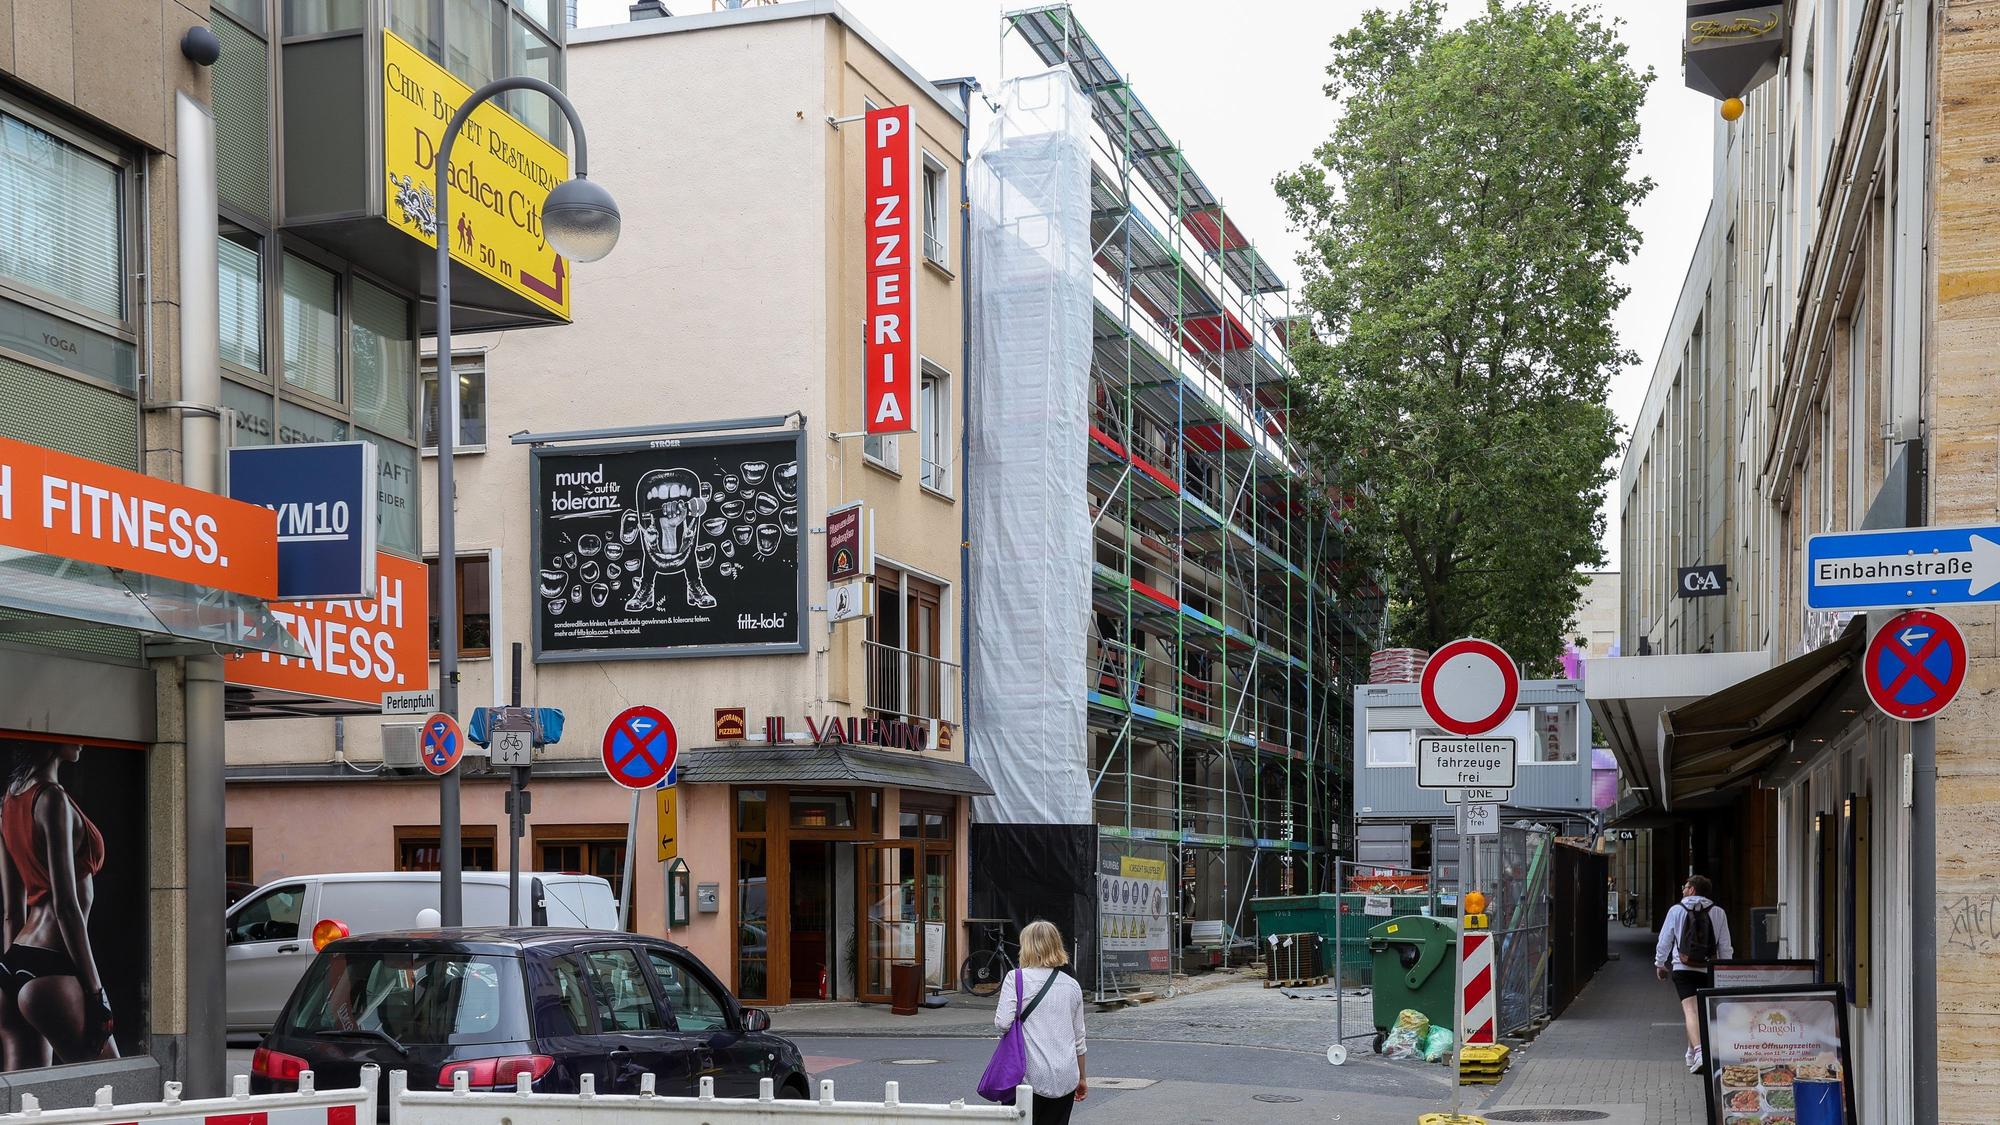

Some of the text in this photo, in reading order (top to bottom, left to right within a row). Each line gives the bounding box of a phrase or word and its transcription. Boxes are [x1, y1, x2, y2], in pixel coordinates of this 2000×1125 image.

[386, 62, 427, 111] CHIN.
[479, 243, 512, 278] 50 m
[875, 117, 903, 423] PIZZERIA
[42, 332, 78, 355] YOGA
[650, 440, 680, 448] STRÖER
[378, 459, 411, 484] AFT
[556, 463, 603, 486] mund
[594, 481, 620, 494] auf für
[377, 490, 405, 509] EIDER
[551, 490, 621, 511] toleranz.
[42, 474, 228, 567] FITNESS.
[262, 501, 349, 534] YM10
[1820, 557, 1973, 580] Einbahnstraße
[1684, 570, 1721, 591] C&A
[554, 629, 567, 637] mehr
[567, 628, 577, 637] auf
[387, 694, 435, 711] Perlenpfuhl
[717, 713, 743, 727] RISTORANTE
[719, 728, 742, 736] PIZZERIA
[766, 715, 794, 744] IL
[804, 715, 929, 751] VALENTINO
[1431, 741, 1507, 753] Baustellen-
[1437, 756, 1501, 770] fahrzeuge
[1458, 771, 1480, 783] frei
[1467, 790, 1494, 799] ONE
[664, 799, 670, 814] U
[1470, 819, 1485, 827] frei
[1758, 1023, 1796, 1037] Rangoli
[1733, 1042, 1821, 1051] Unsere Öffnungszeiten
